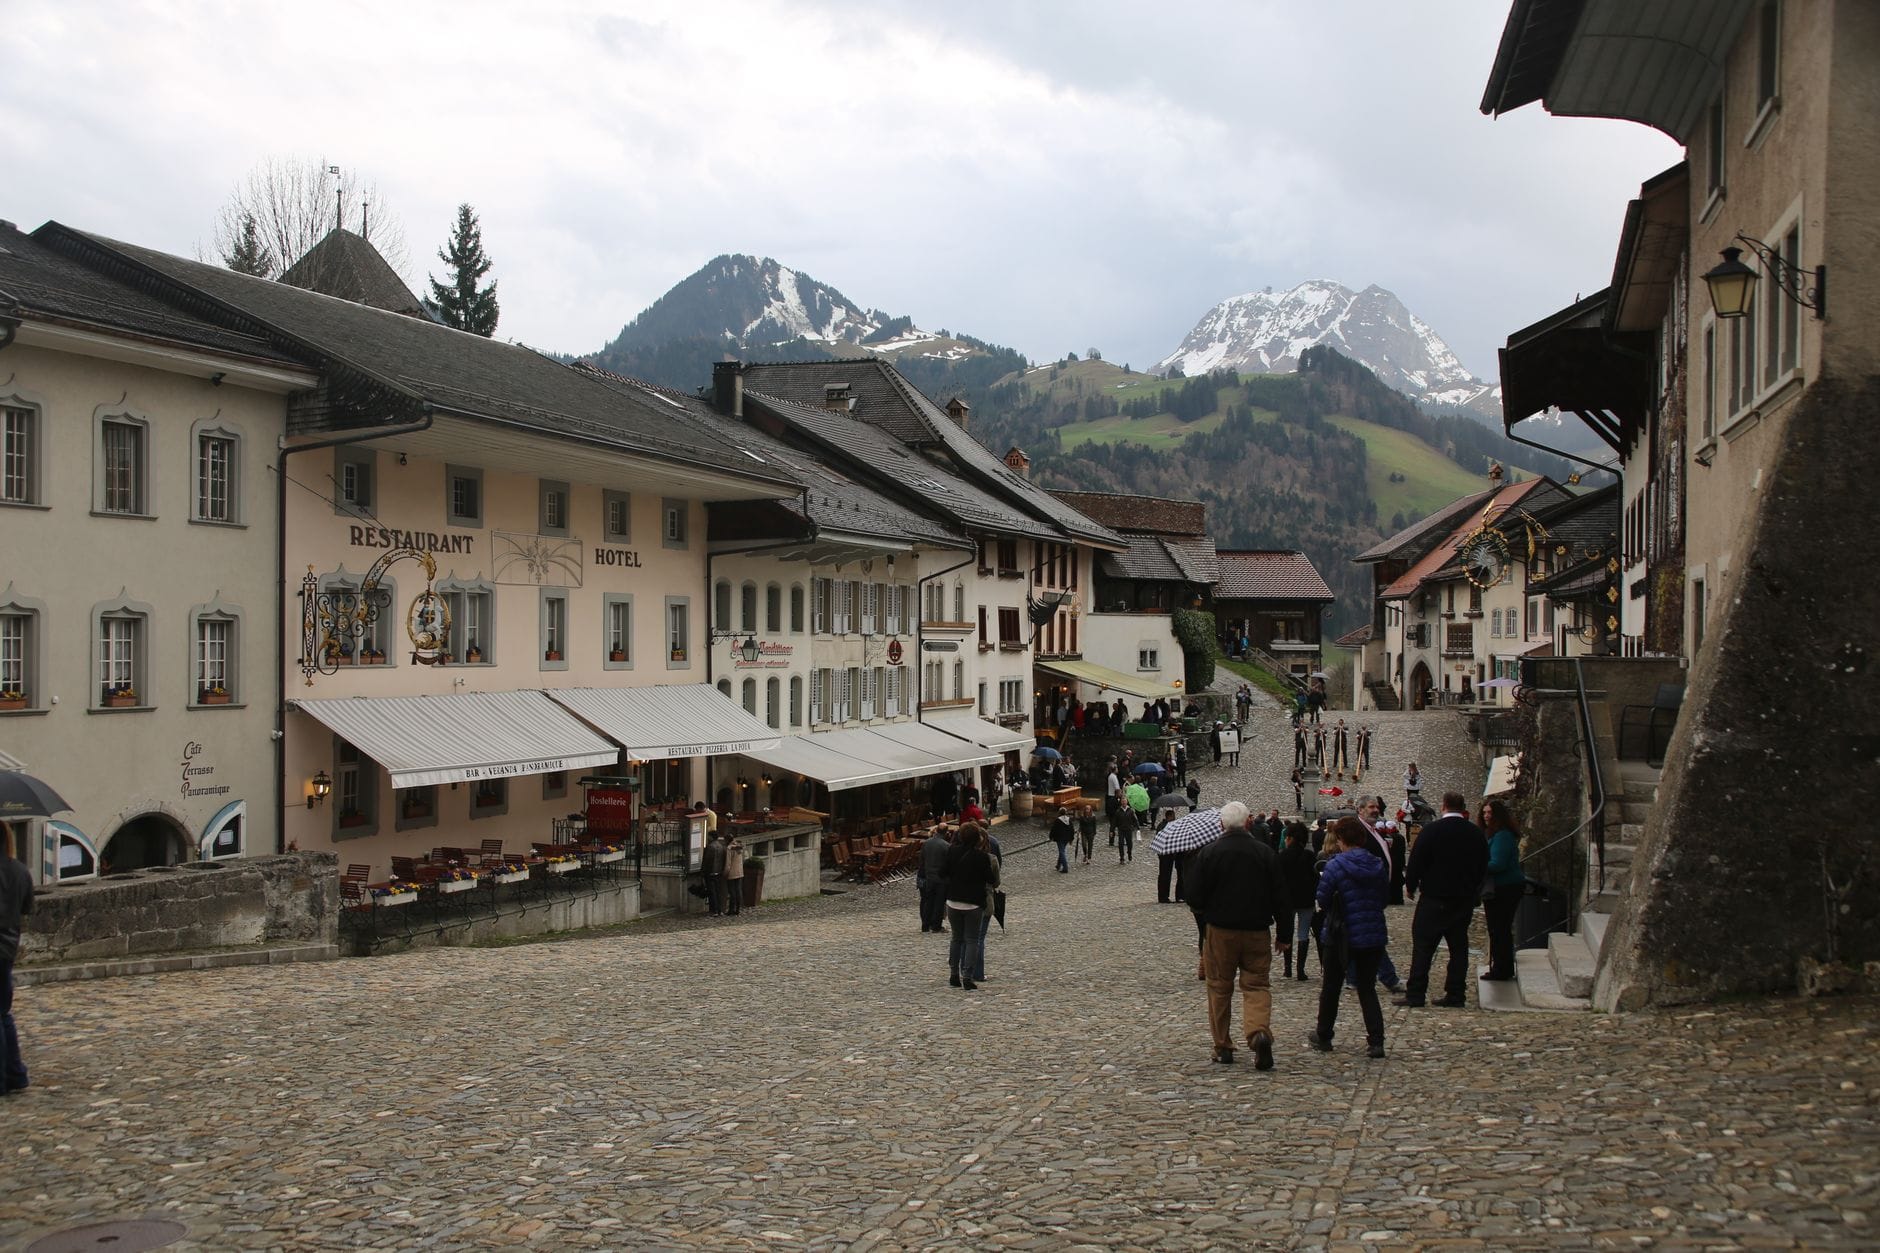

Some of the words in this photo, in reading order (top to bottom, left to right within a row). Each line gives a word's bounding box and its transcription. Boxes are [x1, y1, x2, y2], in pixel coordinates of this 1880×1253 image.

[350, 525, 473, 554] RESTAURANT
[595, 548, 642, 568] HOTEL
[183, 741, 202, 760] Café
[668, 745, 702, 756] RESTAURANT
[706, 744, 728, 754] PIZZERIA
[181, 761, 215, 780] Terrasse
[466, 767, 480, 778] BAR
[180, 781, 230, 800] Panoramique
[590, 796, 627, 806] Hostellerie
